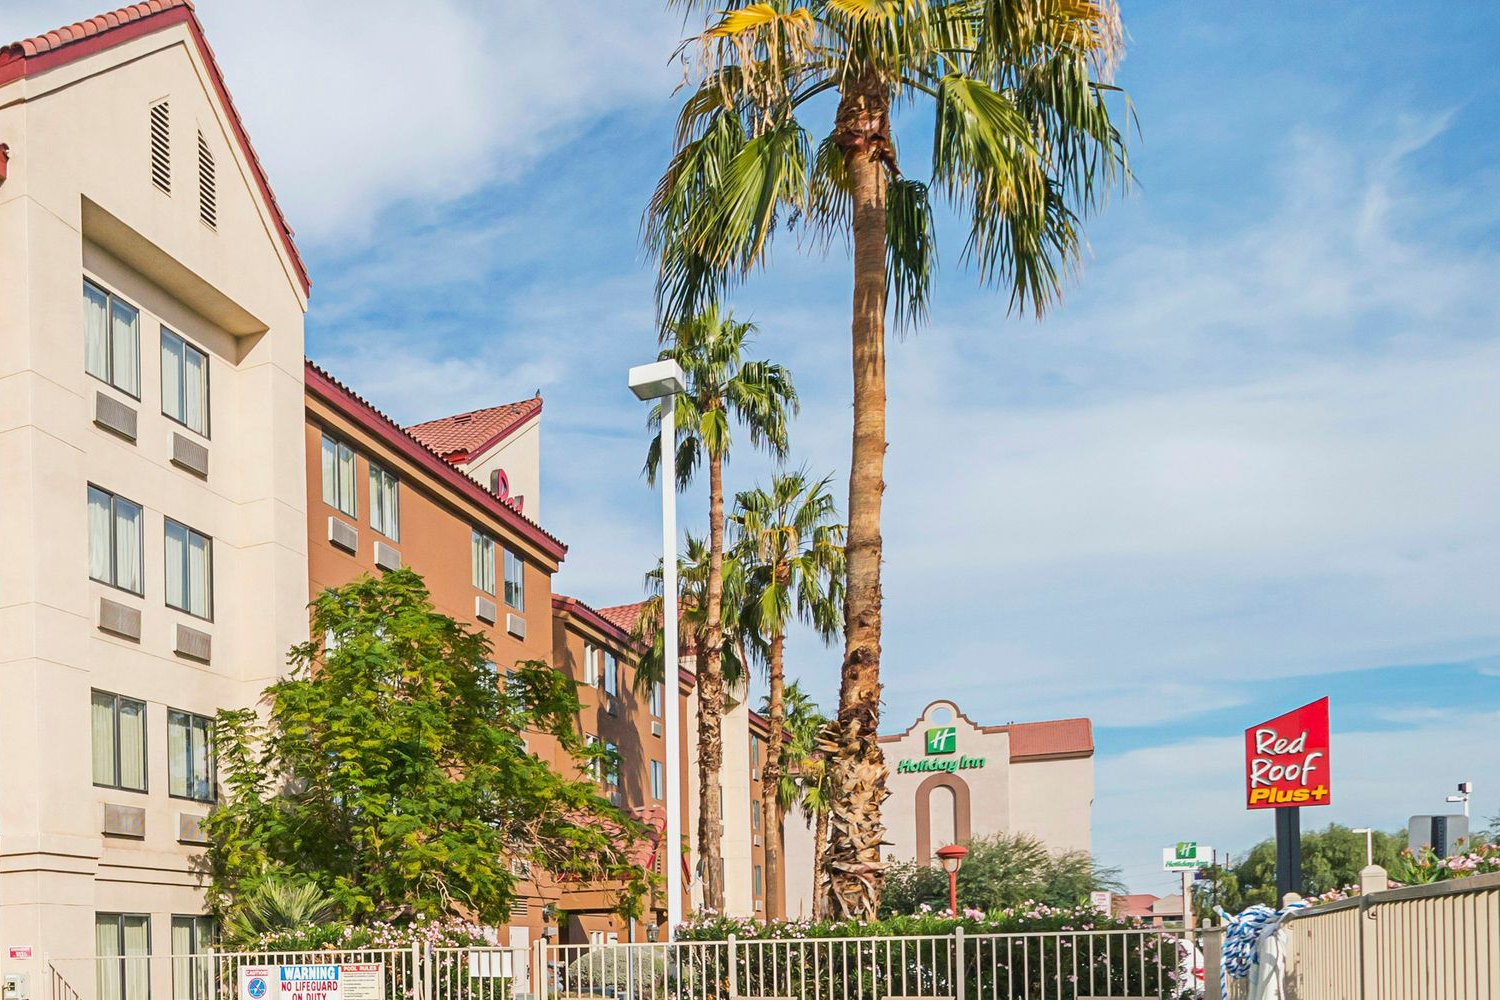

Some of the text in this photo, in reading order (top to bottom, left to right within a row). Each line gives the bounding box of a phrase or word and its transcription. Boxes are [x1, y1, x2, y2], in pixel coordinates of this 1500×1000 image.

[1255, 729, 1307, 755] Red
[897, 755, 986, 773] Holiday Inn
[1250, 752, 1323, 788] Roof
[1249, 785, 1328, 804] Plus+
[1165, 859, 1195, 868] Holiday
[284, 966, 335, 980] WARNING
[281, 981, 338, 991] NO LIFEGUARD
